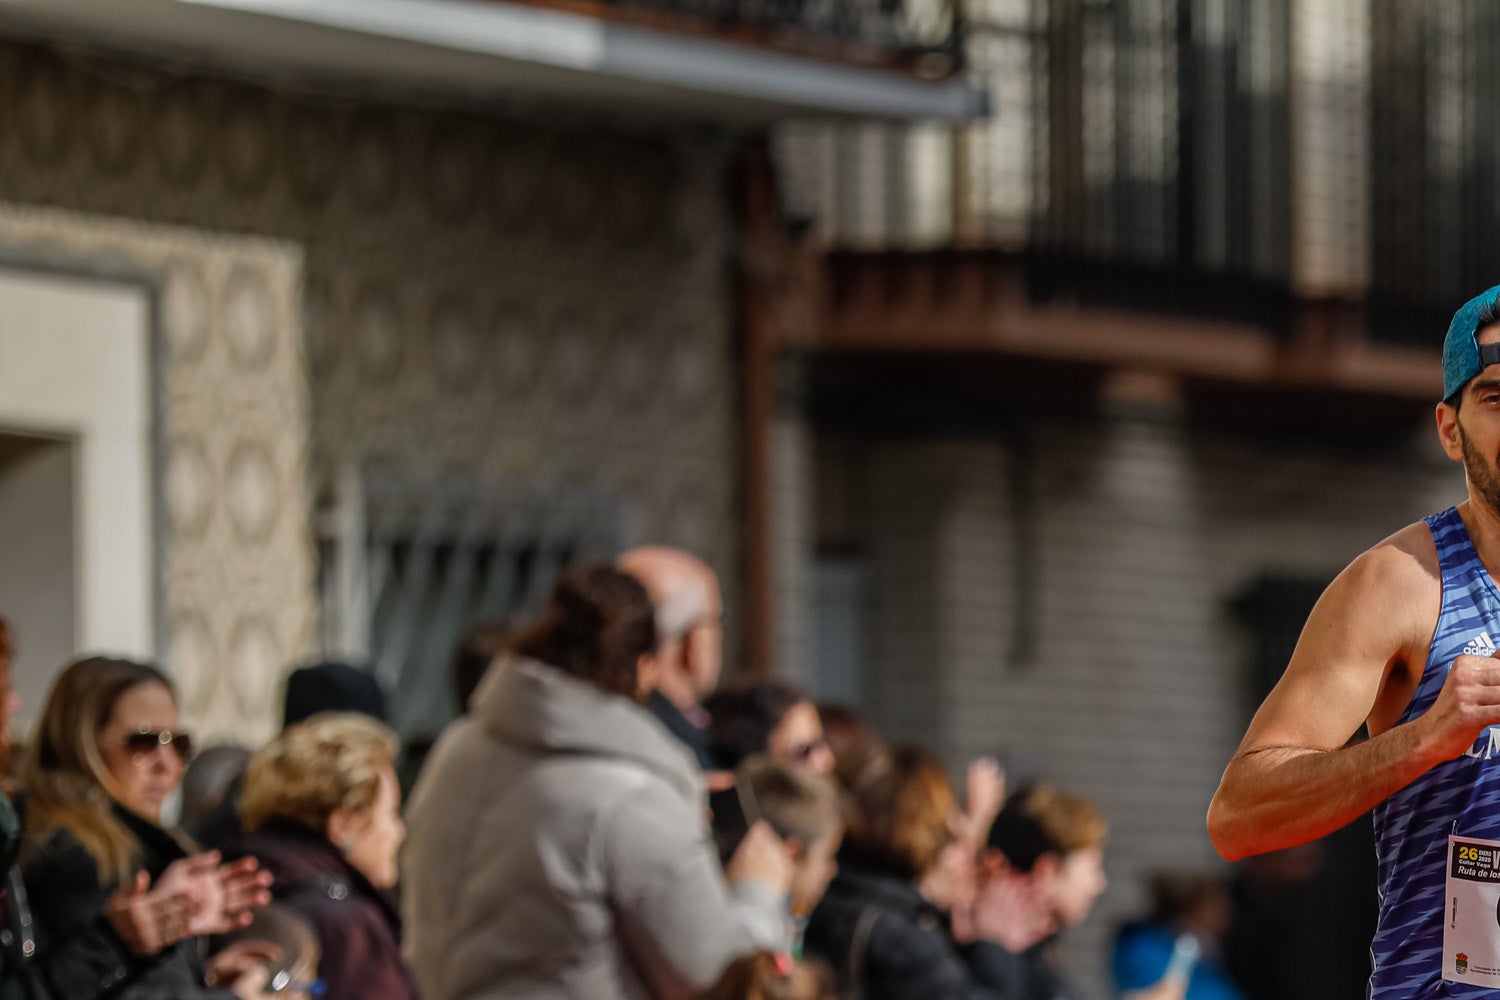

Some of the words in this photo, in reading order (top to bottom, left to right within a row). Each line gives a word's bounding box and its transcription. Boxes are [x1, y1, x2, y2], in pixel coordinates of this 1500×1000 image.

[1463, 646, 1496, 658] adida
[1459, 846, 1478, 861] 26
[1458, 866, 1476, 875] Ruta
[1477, 869, 1488, 878] de
